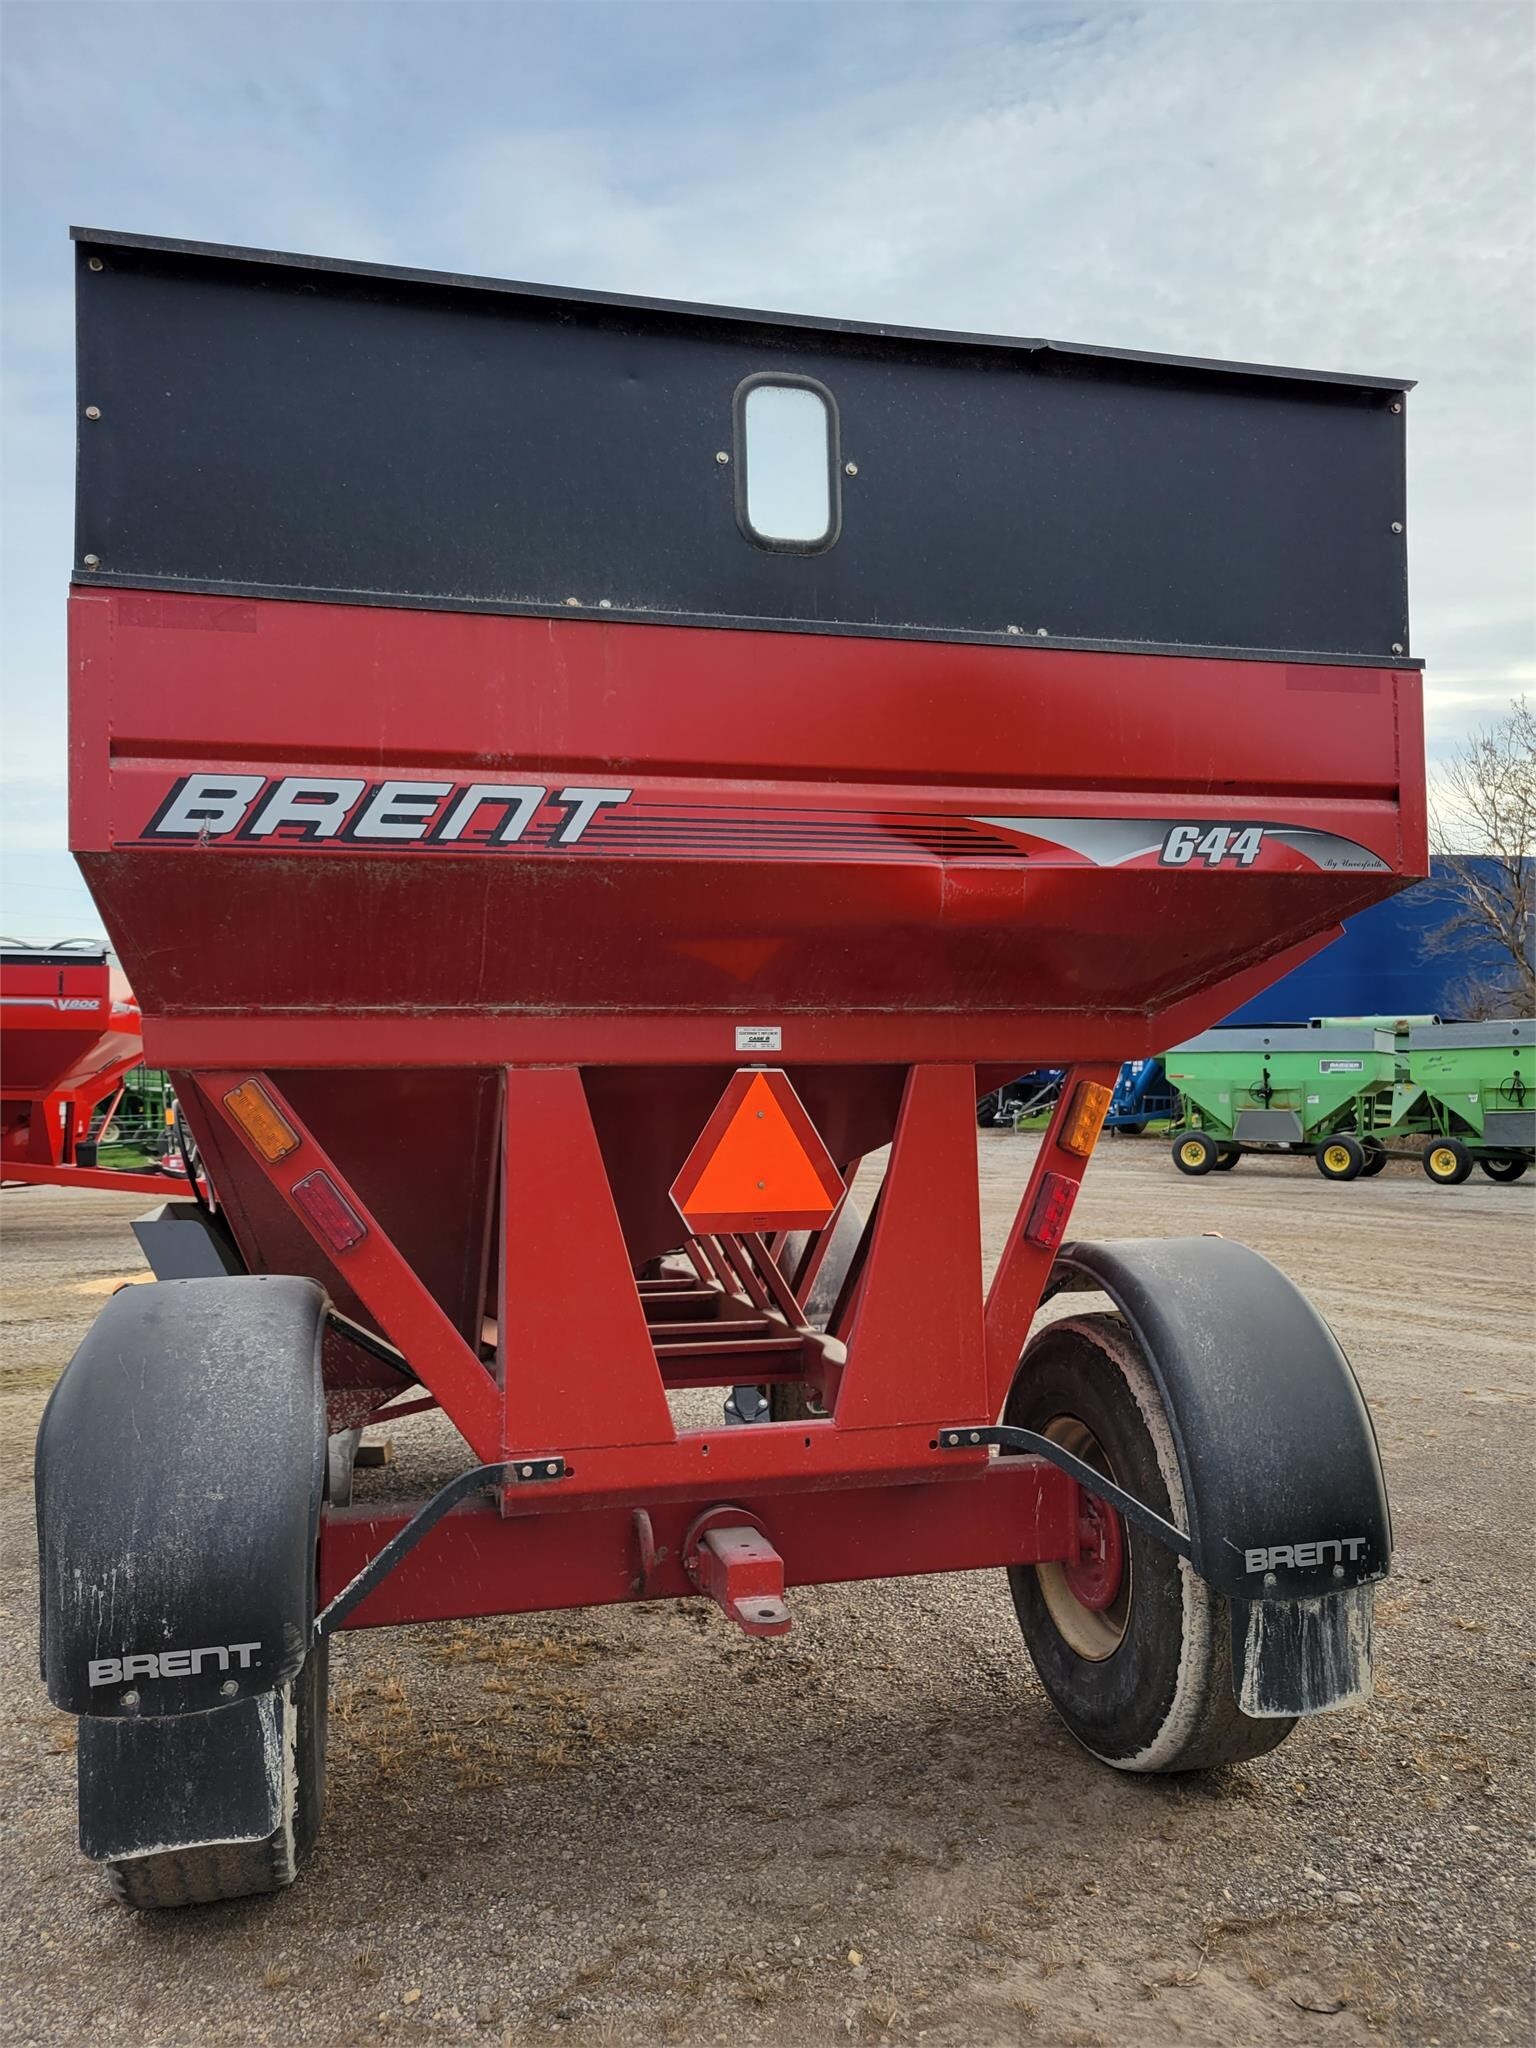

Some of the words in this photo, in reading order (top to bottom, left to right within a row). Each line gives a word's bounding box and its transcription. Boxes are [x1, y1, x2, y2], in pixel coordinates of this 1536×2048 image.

[145, 773, 634, 847] BRENT
[1161, 825, 1264, 867] 644
[1324, 858, 1337, 868] By
[1245, 1537, 1366, 1573] BRENT
[88, 1641, 262, 1687] BRENT
